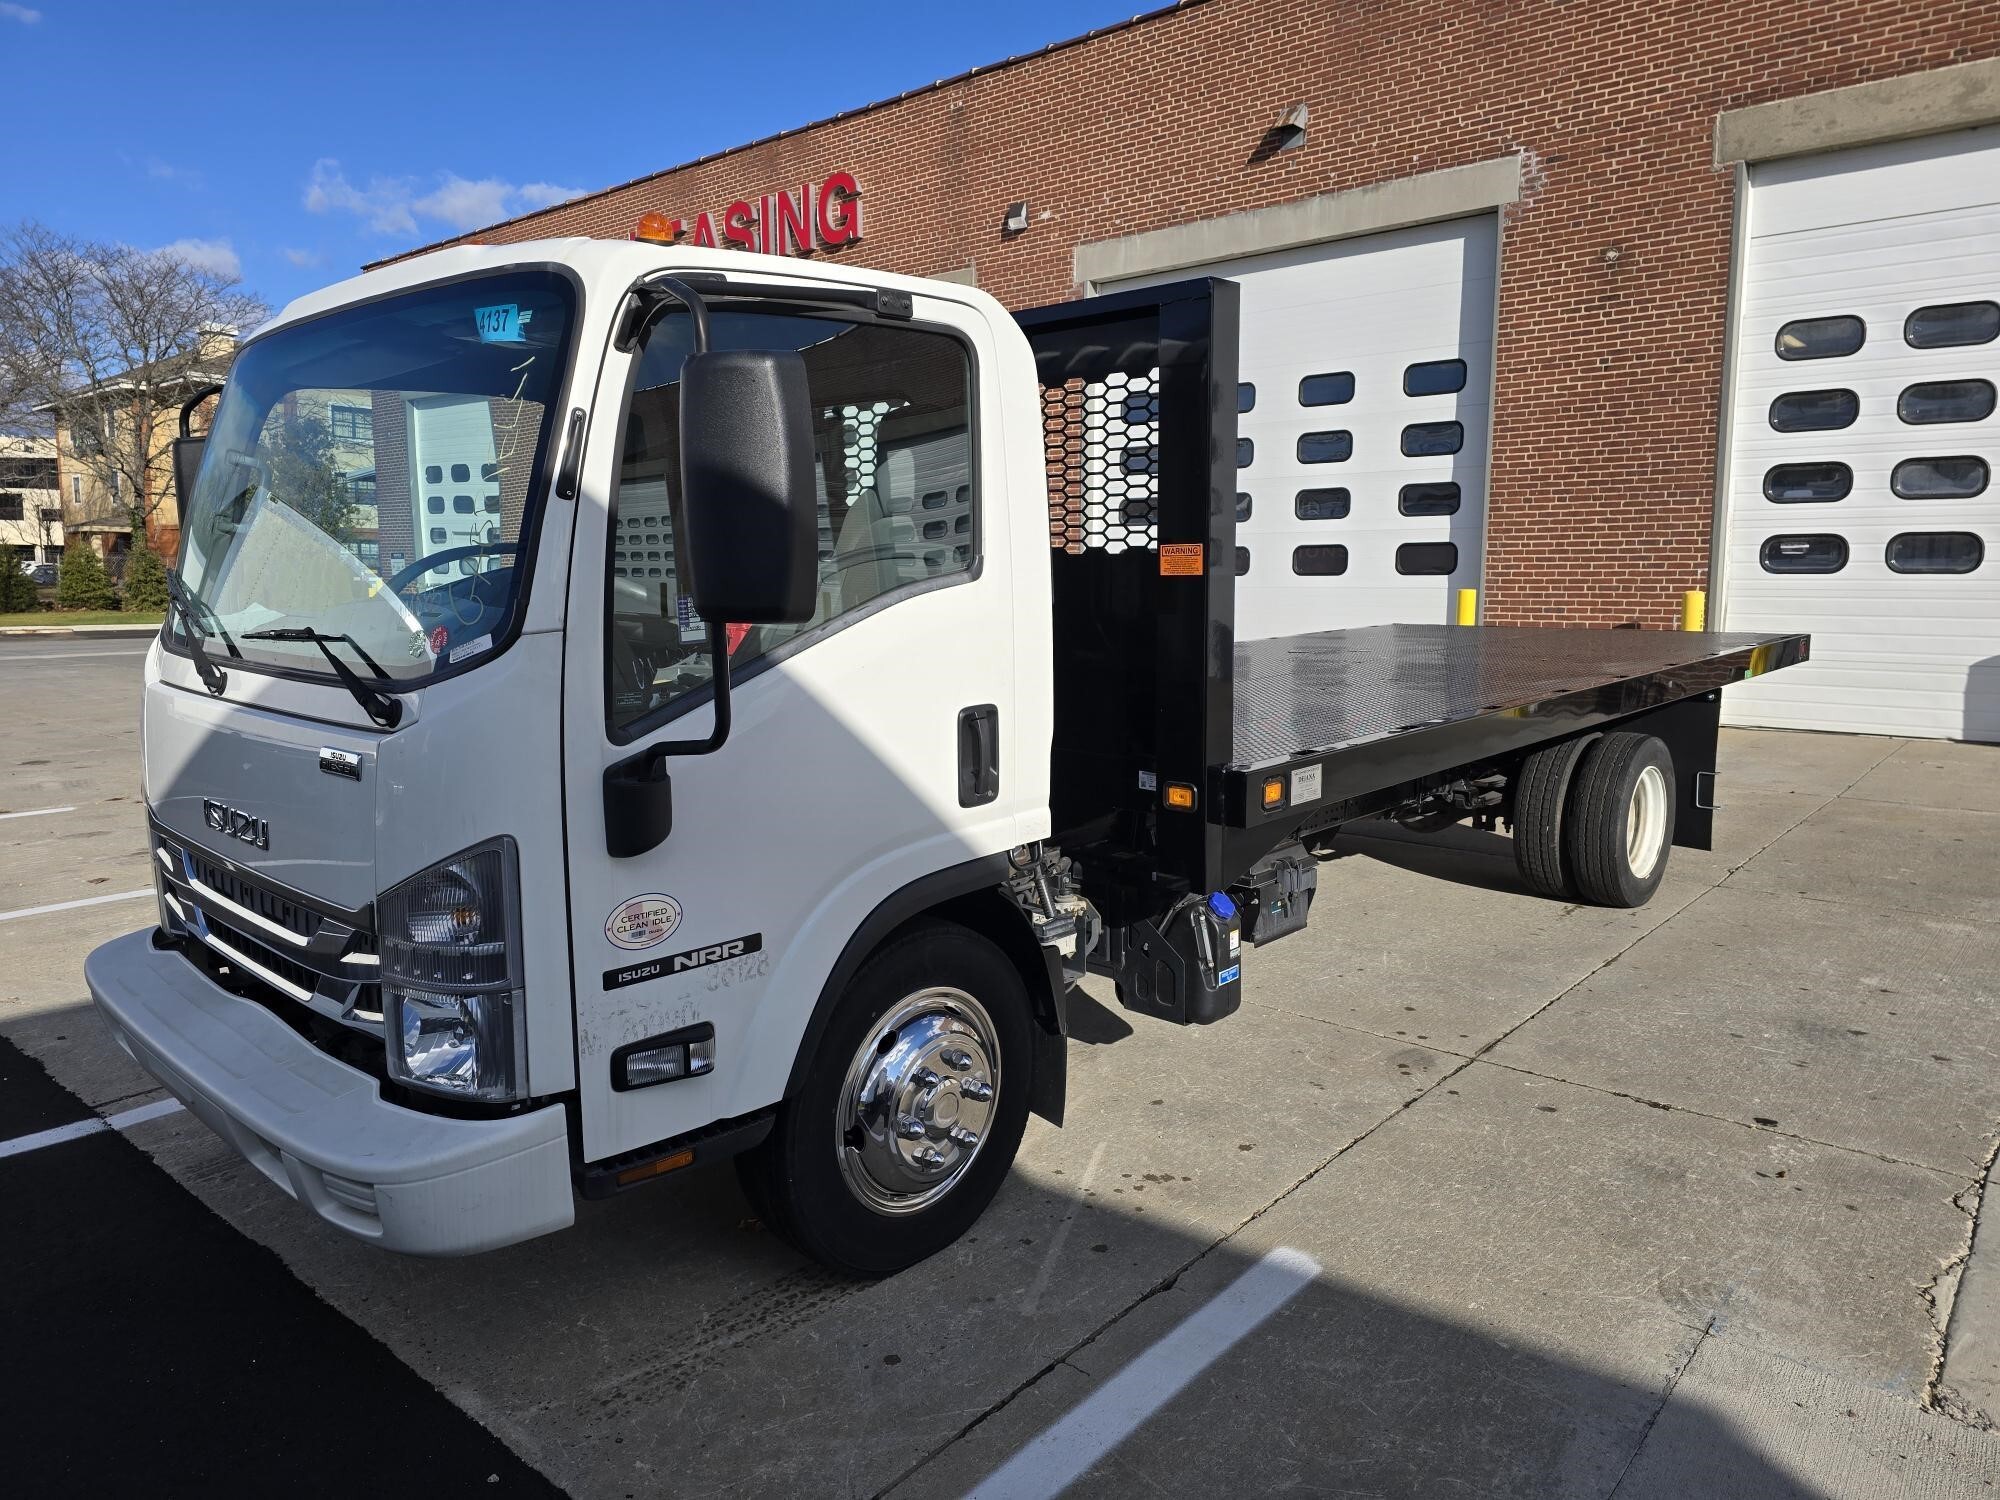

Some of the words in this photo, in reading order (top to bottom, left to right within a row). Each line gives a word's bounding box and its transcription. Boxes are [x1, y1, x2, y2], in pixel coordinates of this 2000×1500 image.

[629, 171, 862, 256] ASING
[479, 308, 510, 334] 4137
[1164, 546, 1199, 555] WARNING
[330, 751, 347, 761] ISUZU
[203, 797, 270, 851] ISUZU
[616, 920, 649, 934] CLEAN
[651, 915, 673, 927] IDLE
[620, 907, 668, 924] CERTIFIED
[617, 964, 661, 983] ISUZU
[673, 940, 745, 972] NRR
